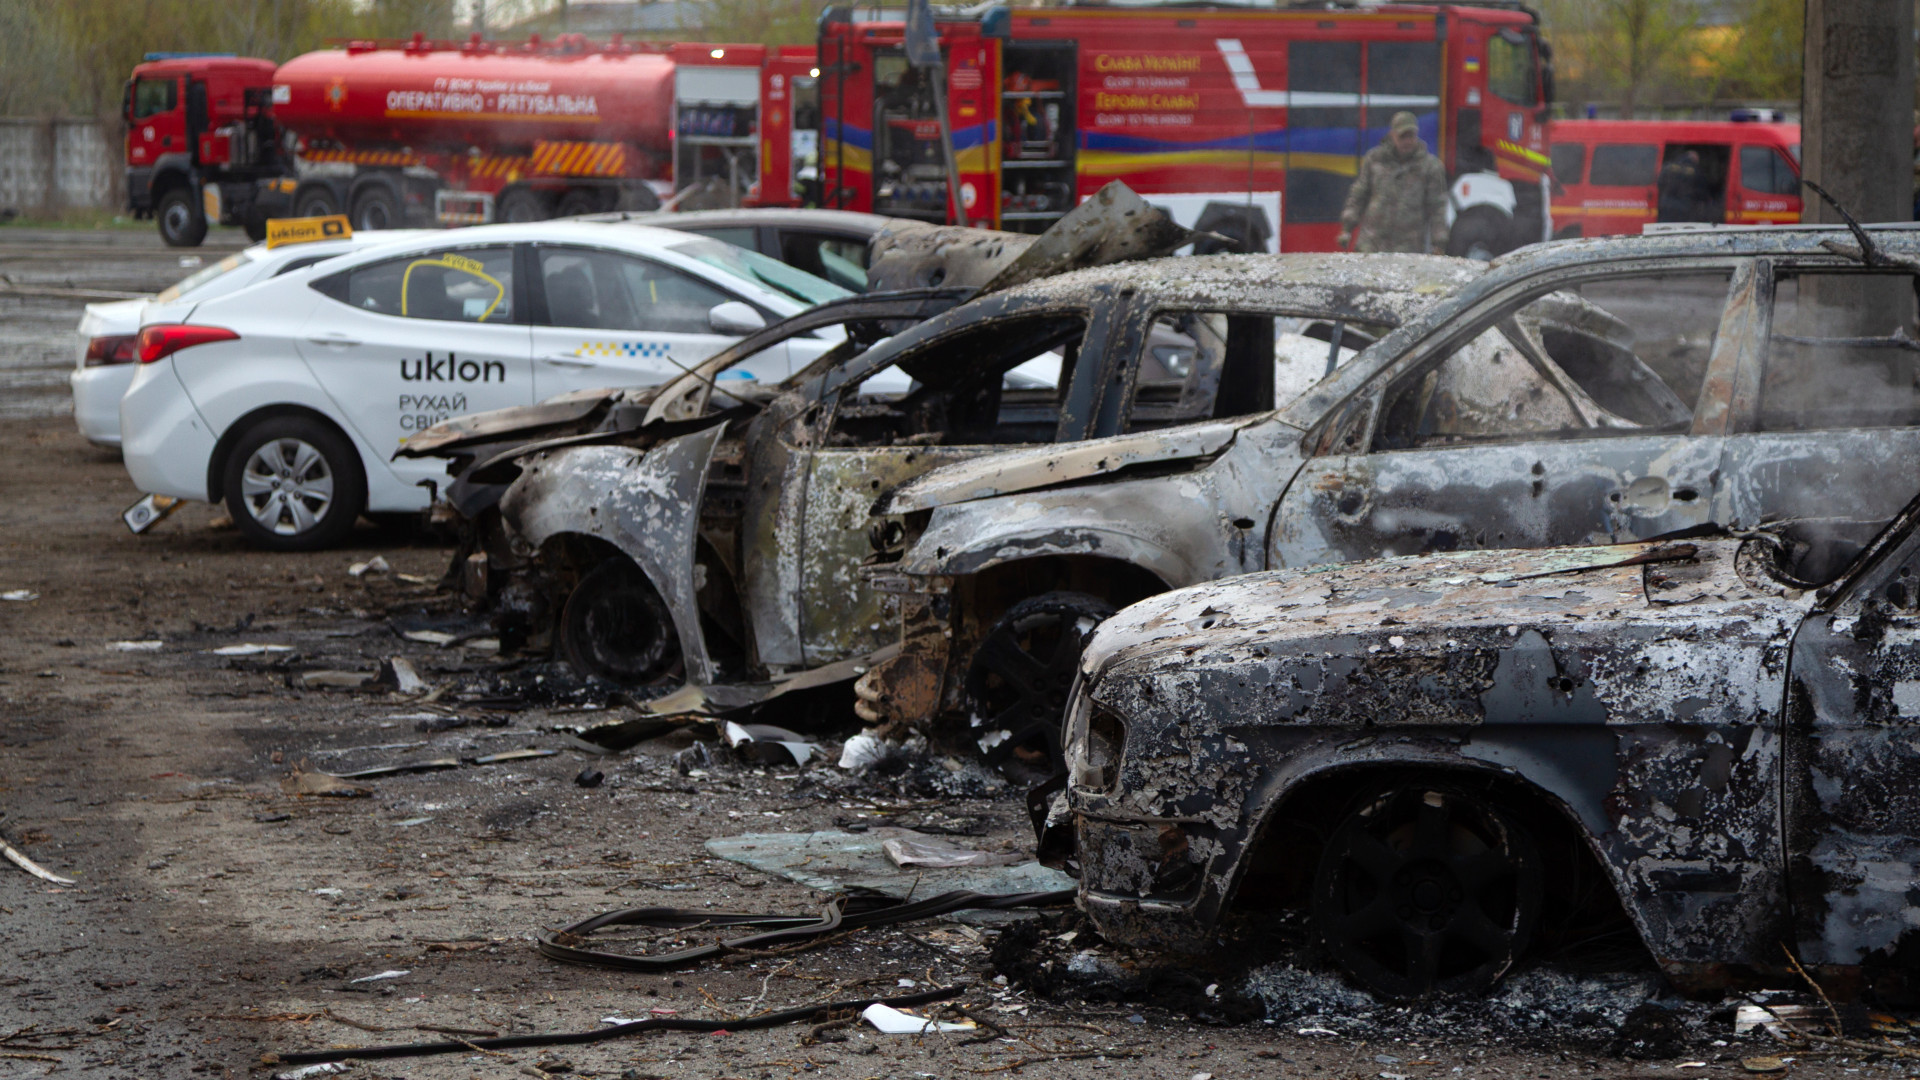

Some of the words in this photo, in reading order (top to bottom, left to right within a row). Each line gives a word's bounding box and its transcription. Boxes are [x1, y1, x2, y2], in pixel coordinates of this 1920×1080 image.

[387, 91, 483, 112] ОПЕРАТИВНО
[498, 94, 598, 114] РЯТУВАЛЬНА
[271, 226, 317, 240] uklon
[401, 351, 505, 382] uklon
[399, 392, 467, 411] РУХАЙ
